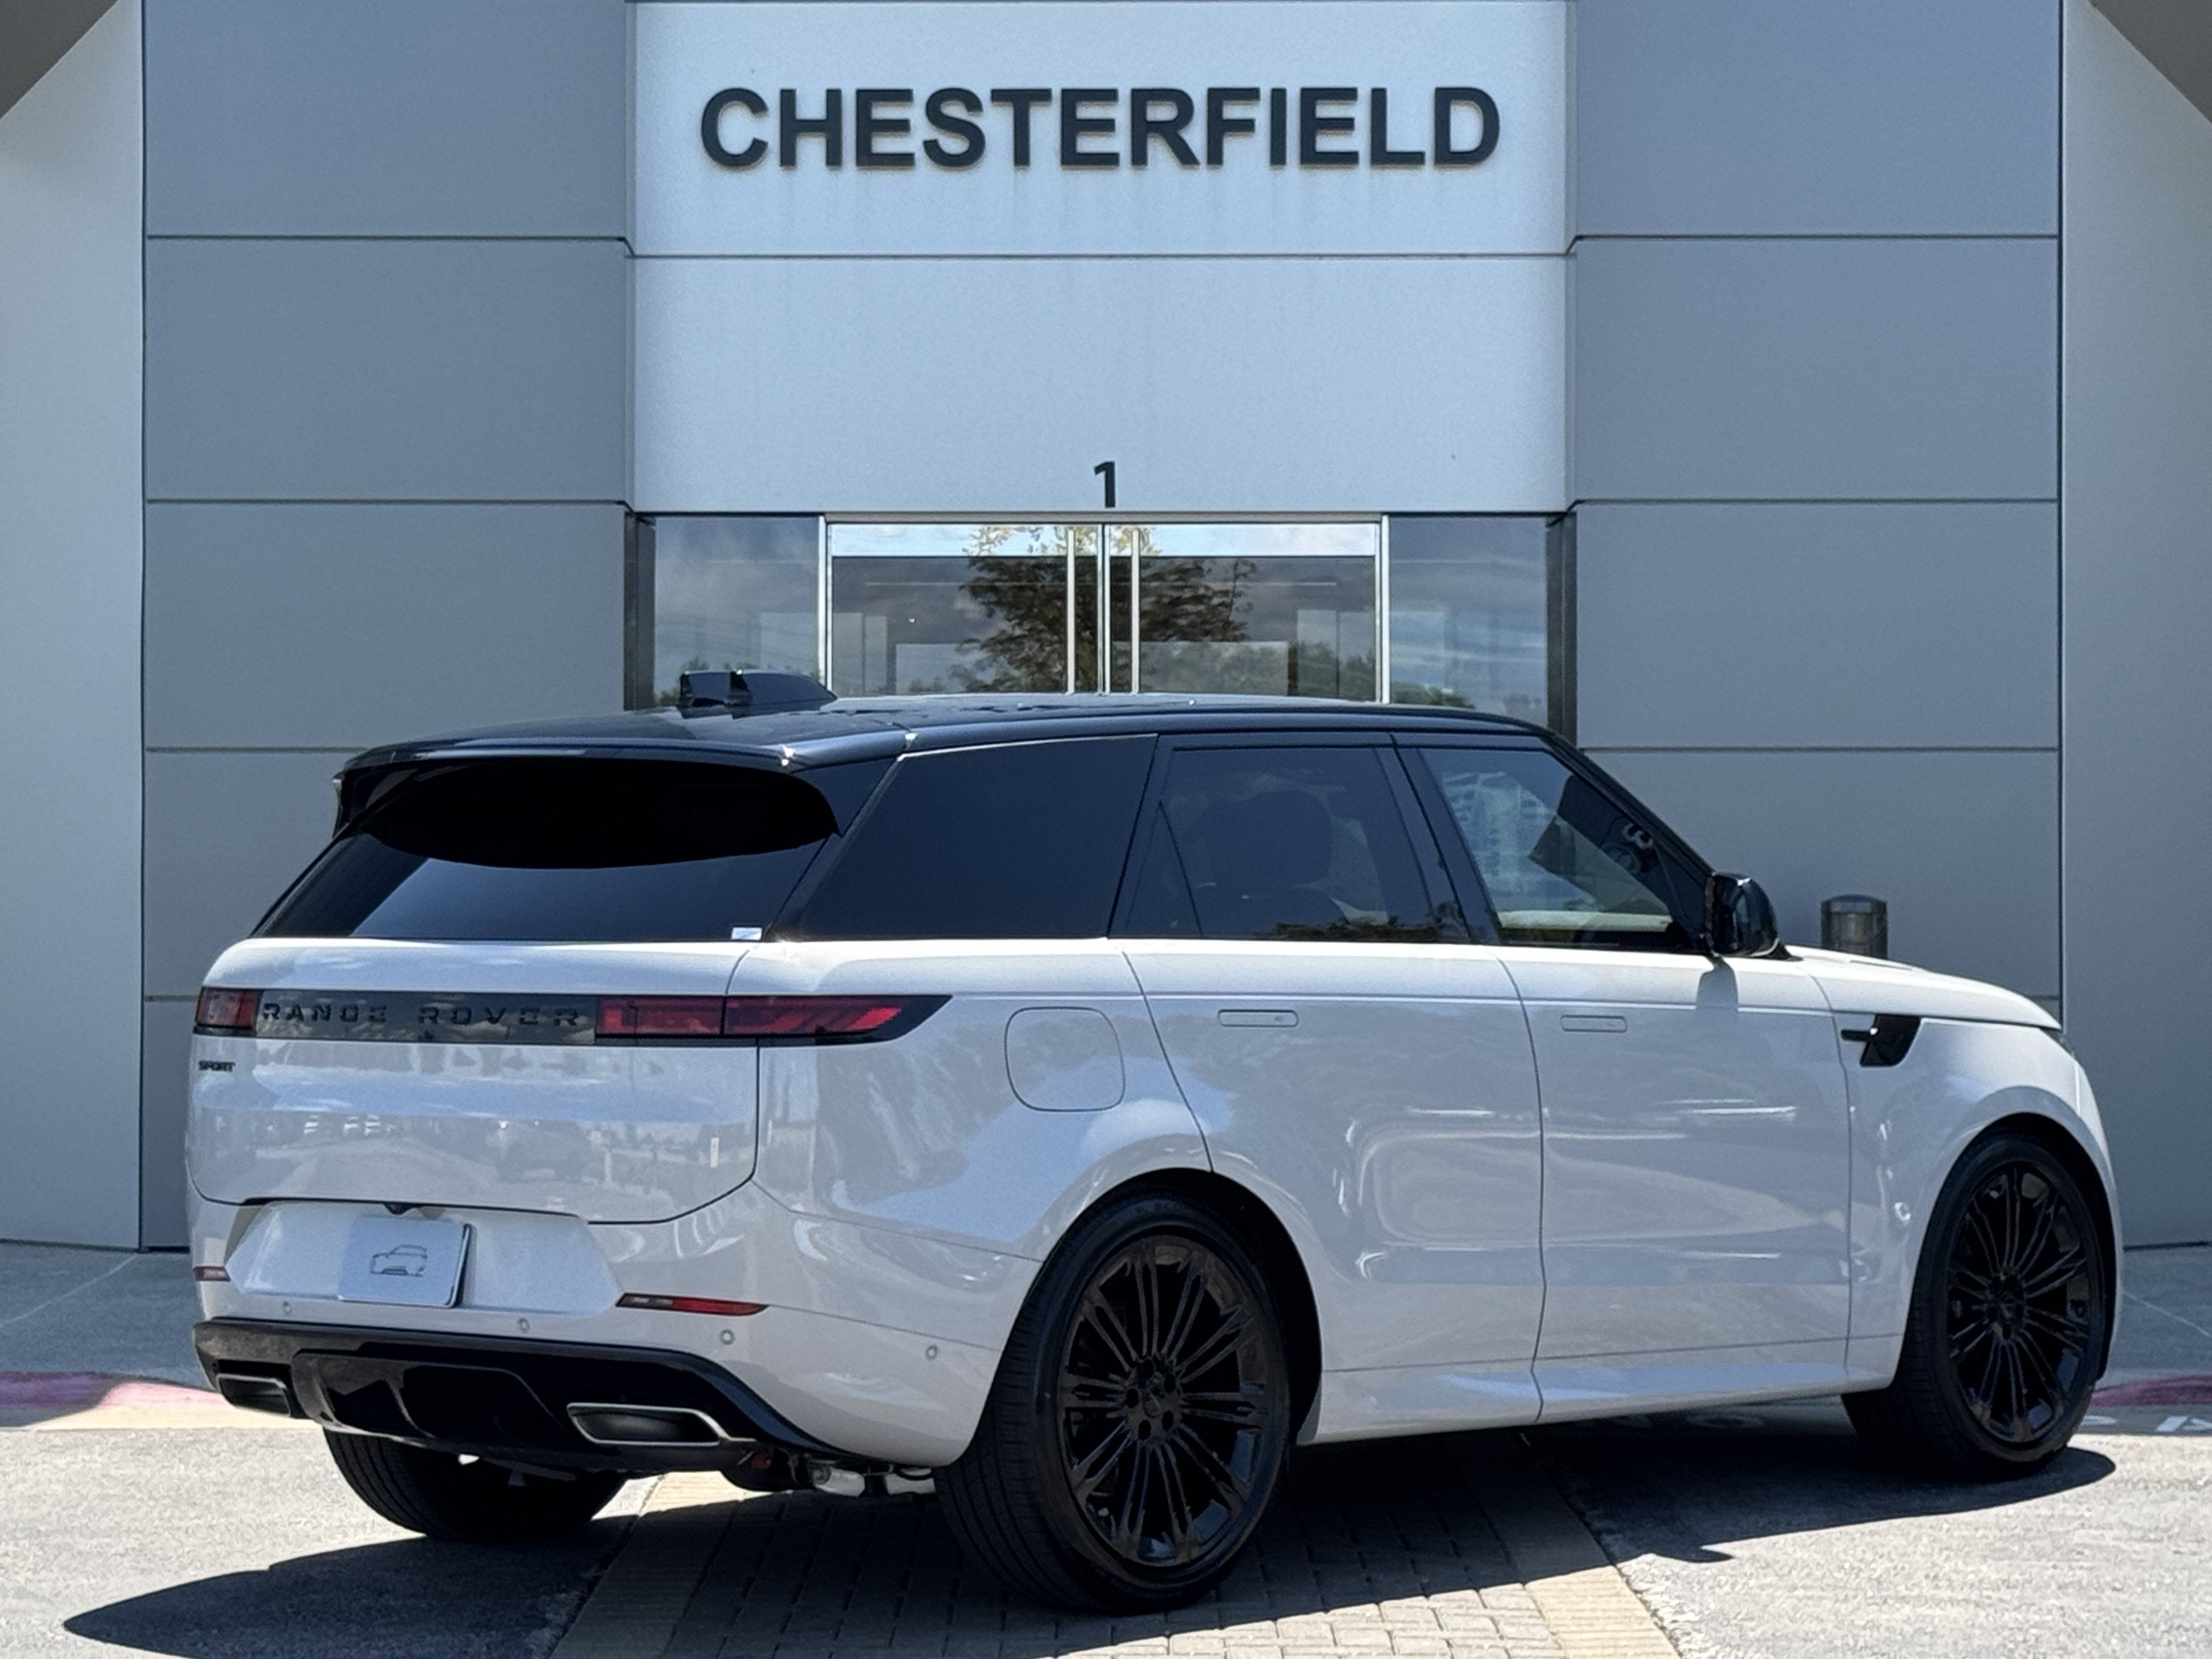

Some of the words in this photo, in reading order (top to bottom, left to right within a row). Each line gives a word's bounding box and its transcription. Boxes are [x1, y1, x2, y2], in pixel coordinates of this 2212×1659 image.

[700, 87, 1501, 168] CHESTERFIELD
[1094, 461, 1116, 509] 1
[263, 1003, 387, 1023] RANGE
[417, 1006, 579, 1026] ROVER
